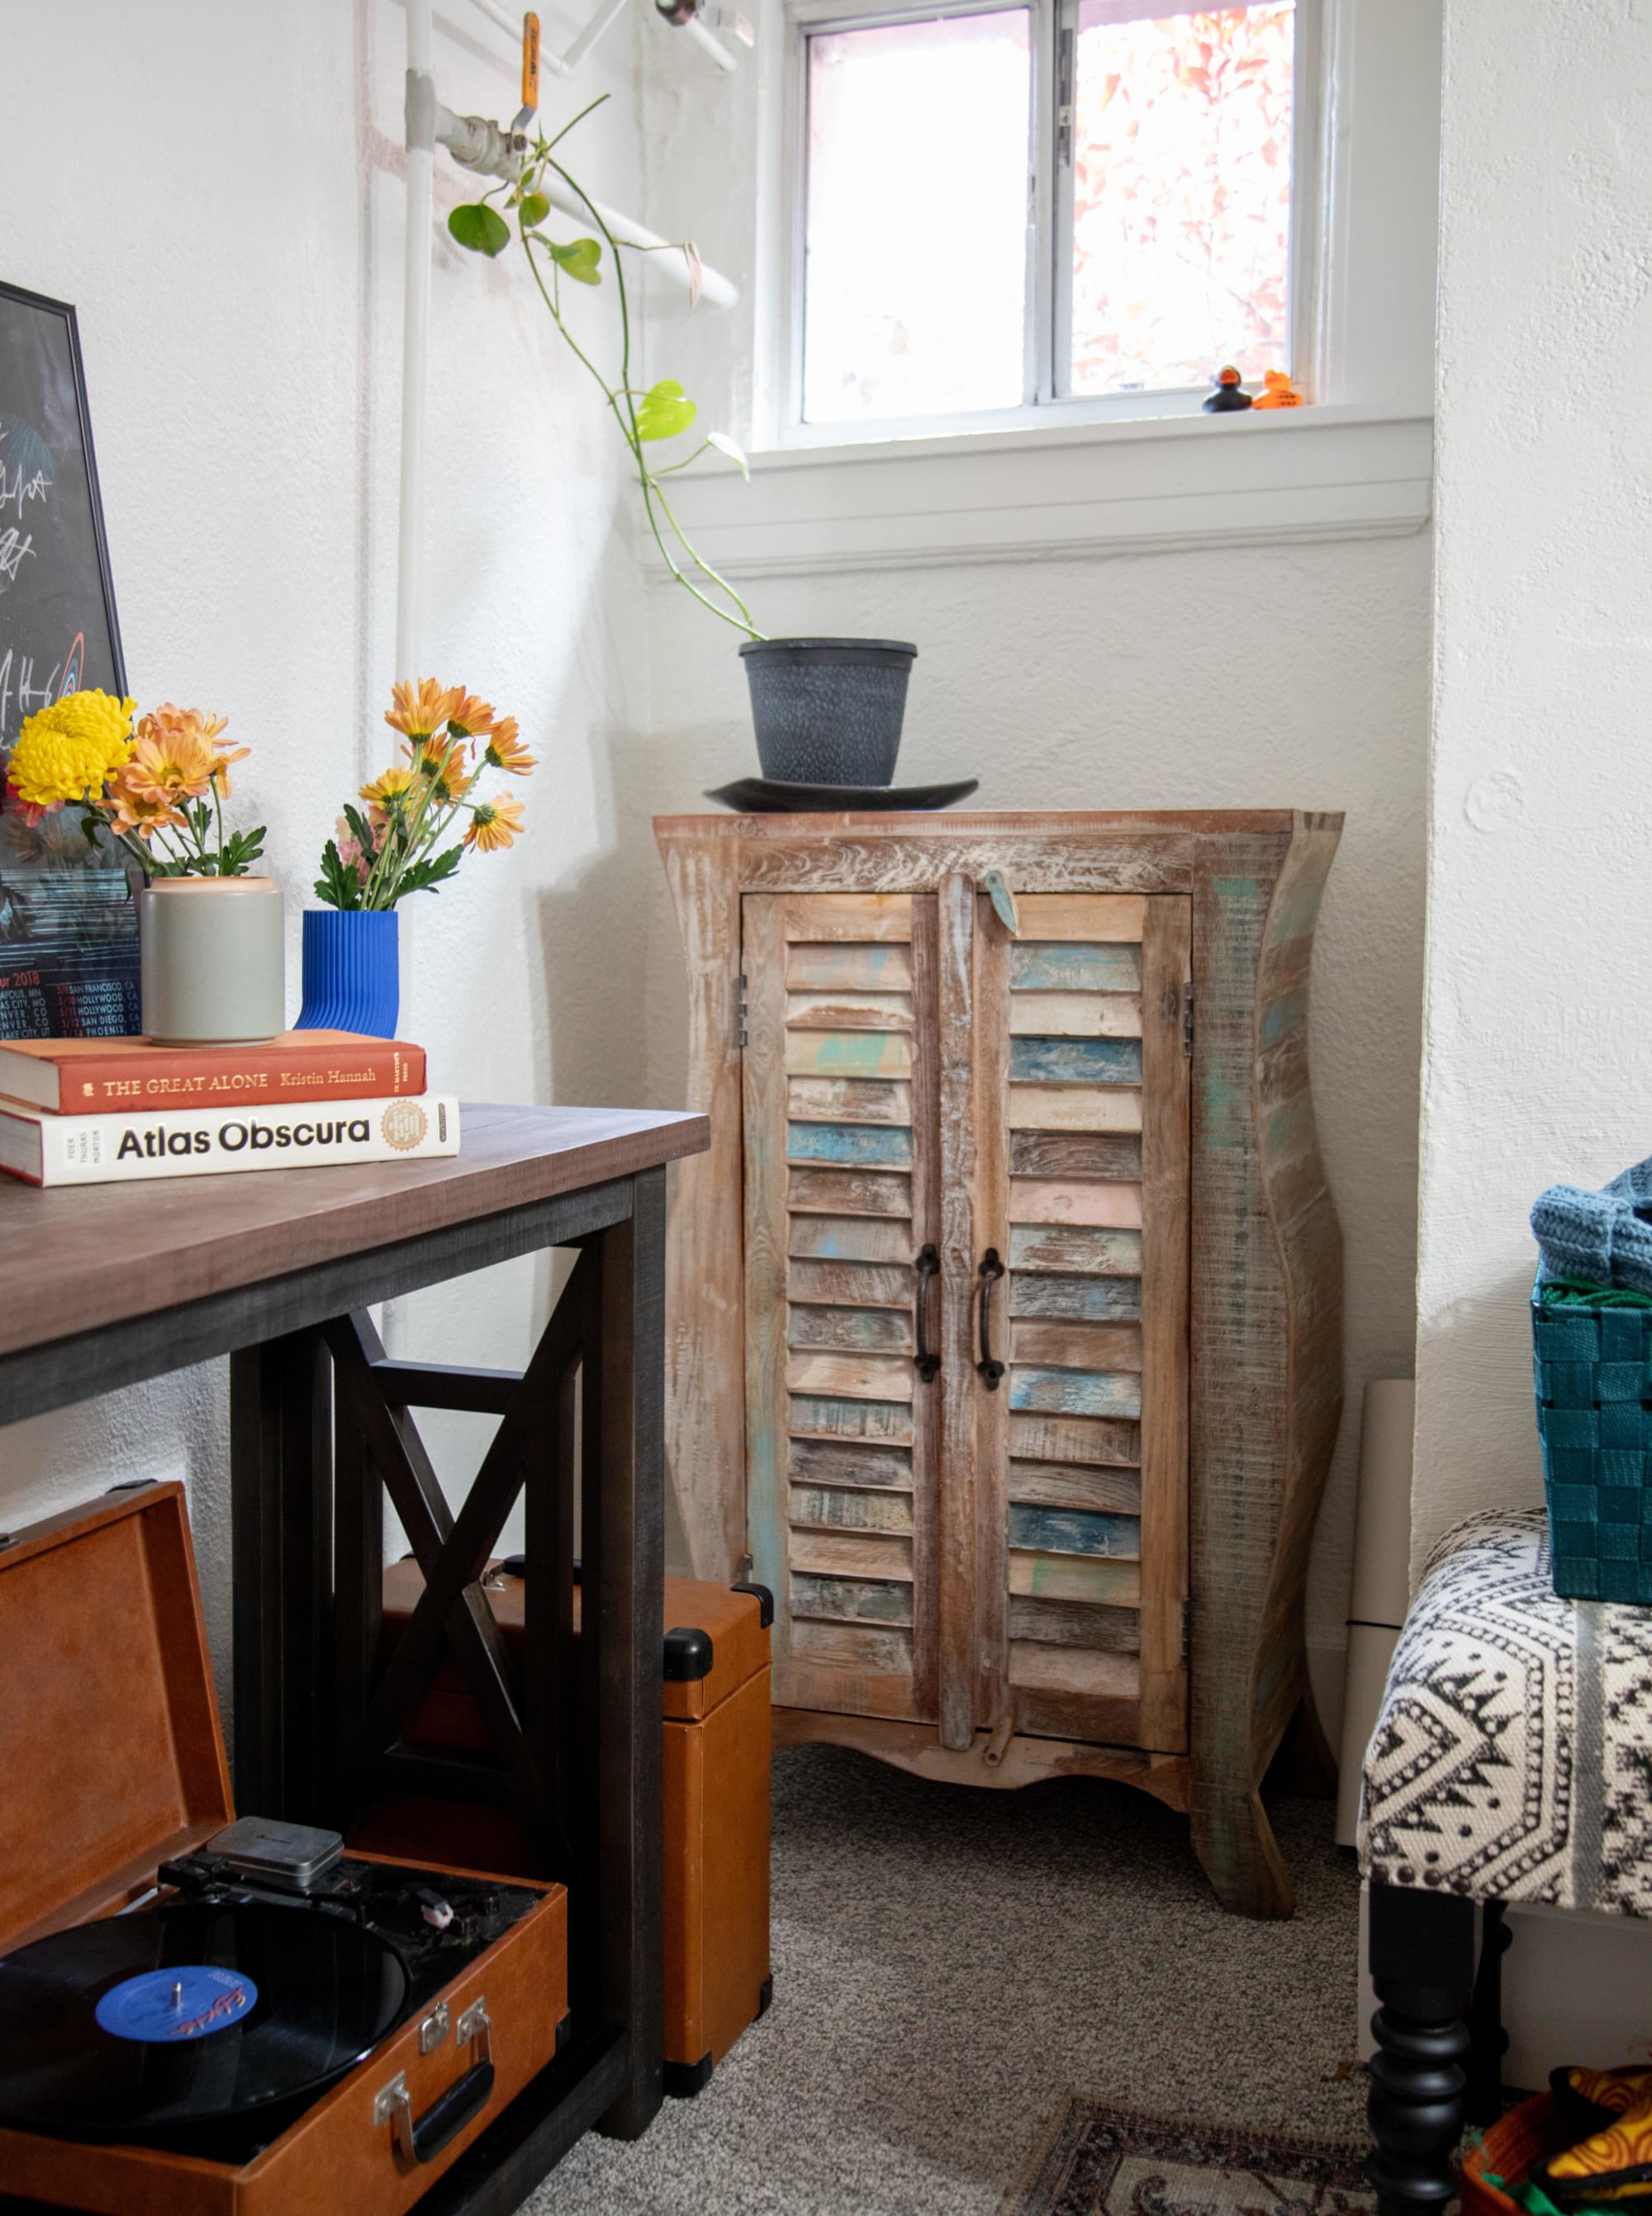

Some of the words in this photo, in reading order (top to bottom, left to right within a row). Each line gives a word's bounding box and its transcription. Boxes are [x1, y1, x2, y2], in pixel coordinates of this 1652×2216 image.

[13, 971, 40, 987] 2018
[28, 987, 41, 997] MN
[69, 984, 83, 995] SAN
[125, 979, 135, 990] CA
[33, 996, 46, 1007] MO
[58, 996, 76, 1006] 5/10
[127, 991, 138, 1001] CA
[129, 1001, 139, 1011] CA
[34, 1007, 47, 1018] CO
[62, 1017, 80, 1028] 5/12
[81, 1015, 97, 1027] SAN
[130, 1012, 140, 1022] CA
[36, 1017, 50, 1027] CO
[41, 1026, 50, 1037] UT
[102, 1080, 142, 1096] THE
[146, 1077, 206, 1095] GREAT
[208, 1073, 268, 1091] ALONE
[280, 1072, 325, 1087] Kristin
[327, 1068, 377, 1084] Hannah
[116, 1123, 211, 1160] Atlas
[218, 1115, 370, 1152] Obscura
